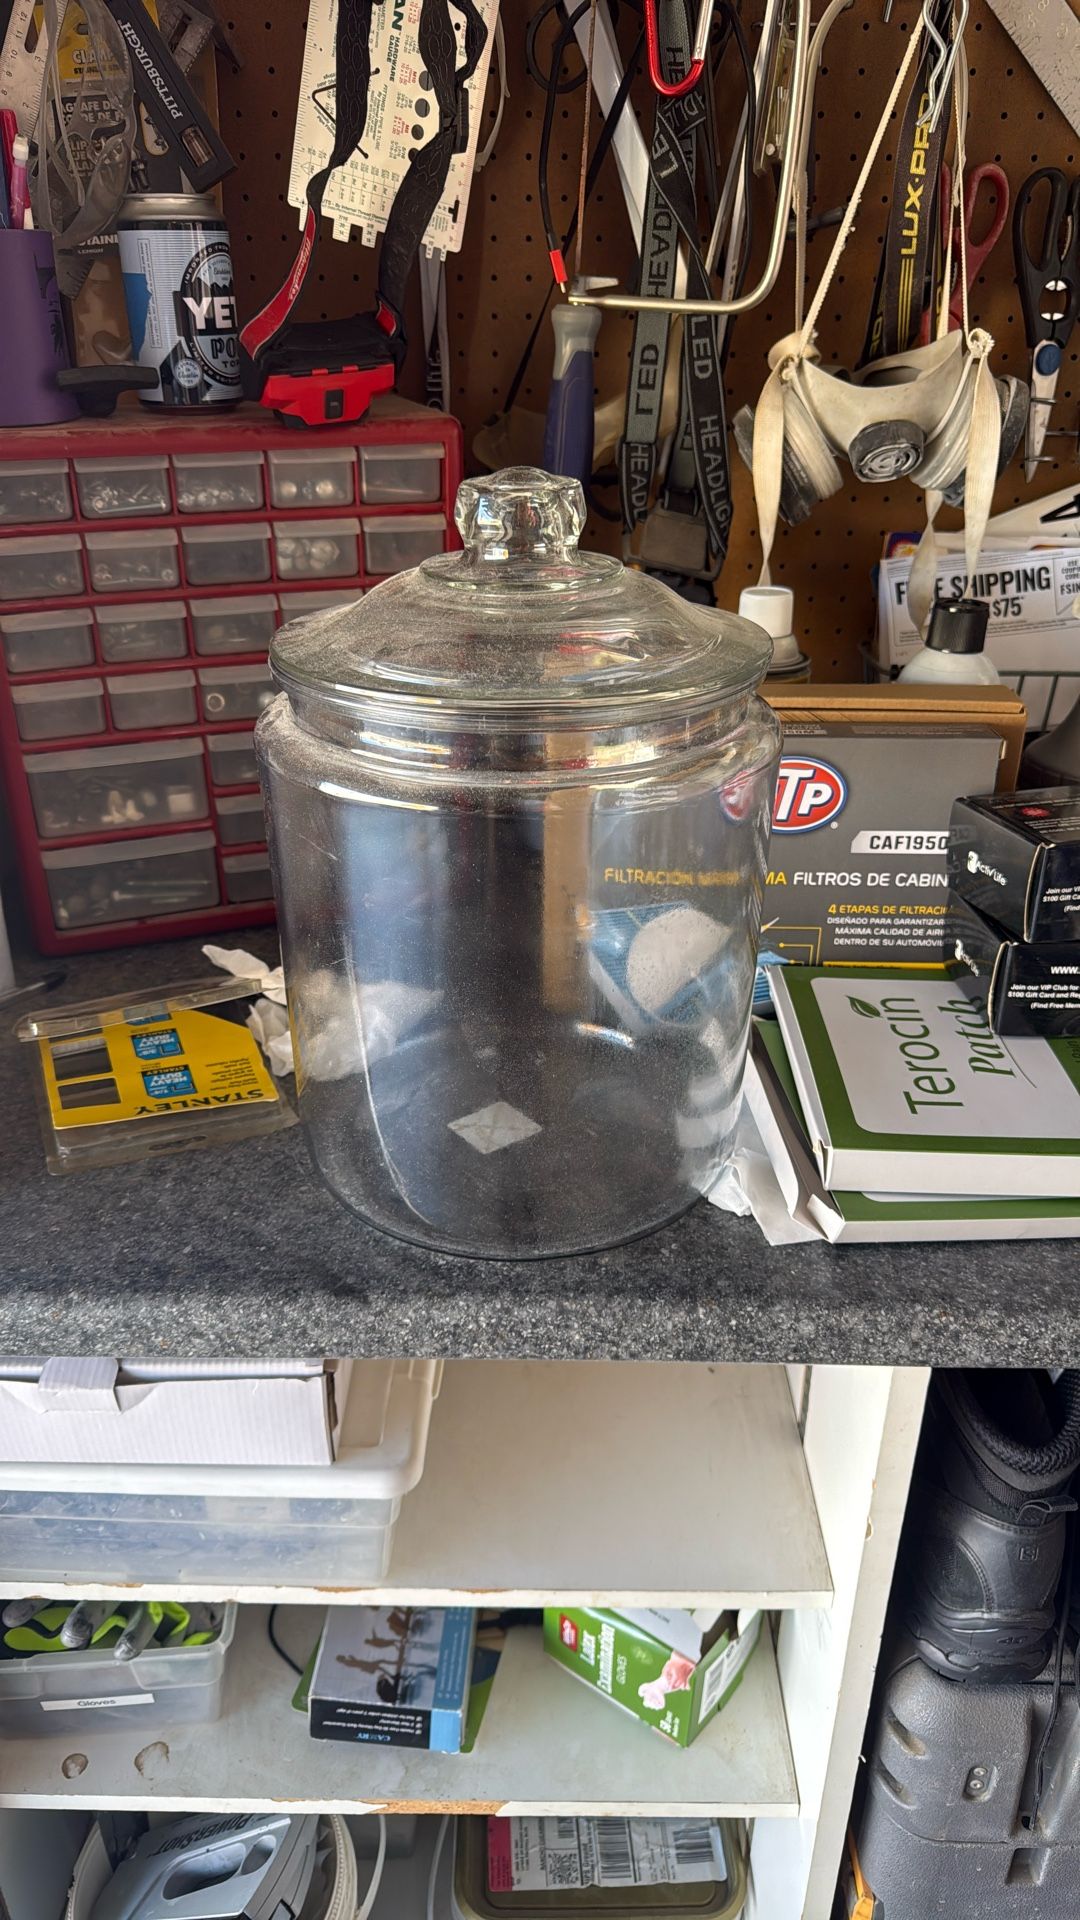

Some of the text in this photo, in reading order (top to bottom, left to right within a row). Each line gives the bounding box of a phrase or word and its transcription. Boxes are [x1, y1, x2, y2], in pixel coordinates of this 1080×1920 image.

[390, 37, 400, 82] HARDWARE
[120, 20, 184, 121] PITTSBURGH
[895, 578, 942, 605] FE
[793, 872, 862, 886] FILTROS
[866, 873, 891, 886] DE
[828, 904, 837, 914] 4
[839, 905, 880, 914] ETAPAS
[882, 905, 896, 914] DE
[870, 917, 892, 925] PARA
[912, 928, 924, 936] DE
[833, 937, 864, 946] DENTRO
[867, 938, 881, 946] DE
[882, 938, 895, 946] SU
[880, 997, 964, 1114] Terocin
[151, 1076, 187, 1086] HEAVY
[137, 1089, 264, 1115] STANLEY
[77, 1699, 117, 1708] Gloves
